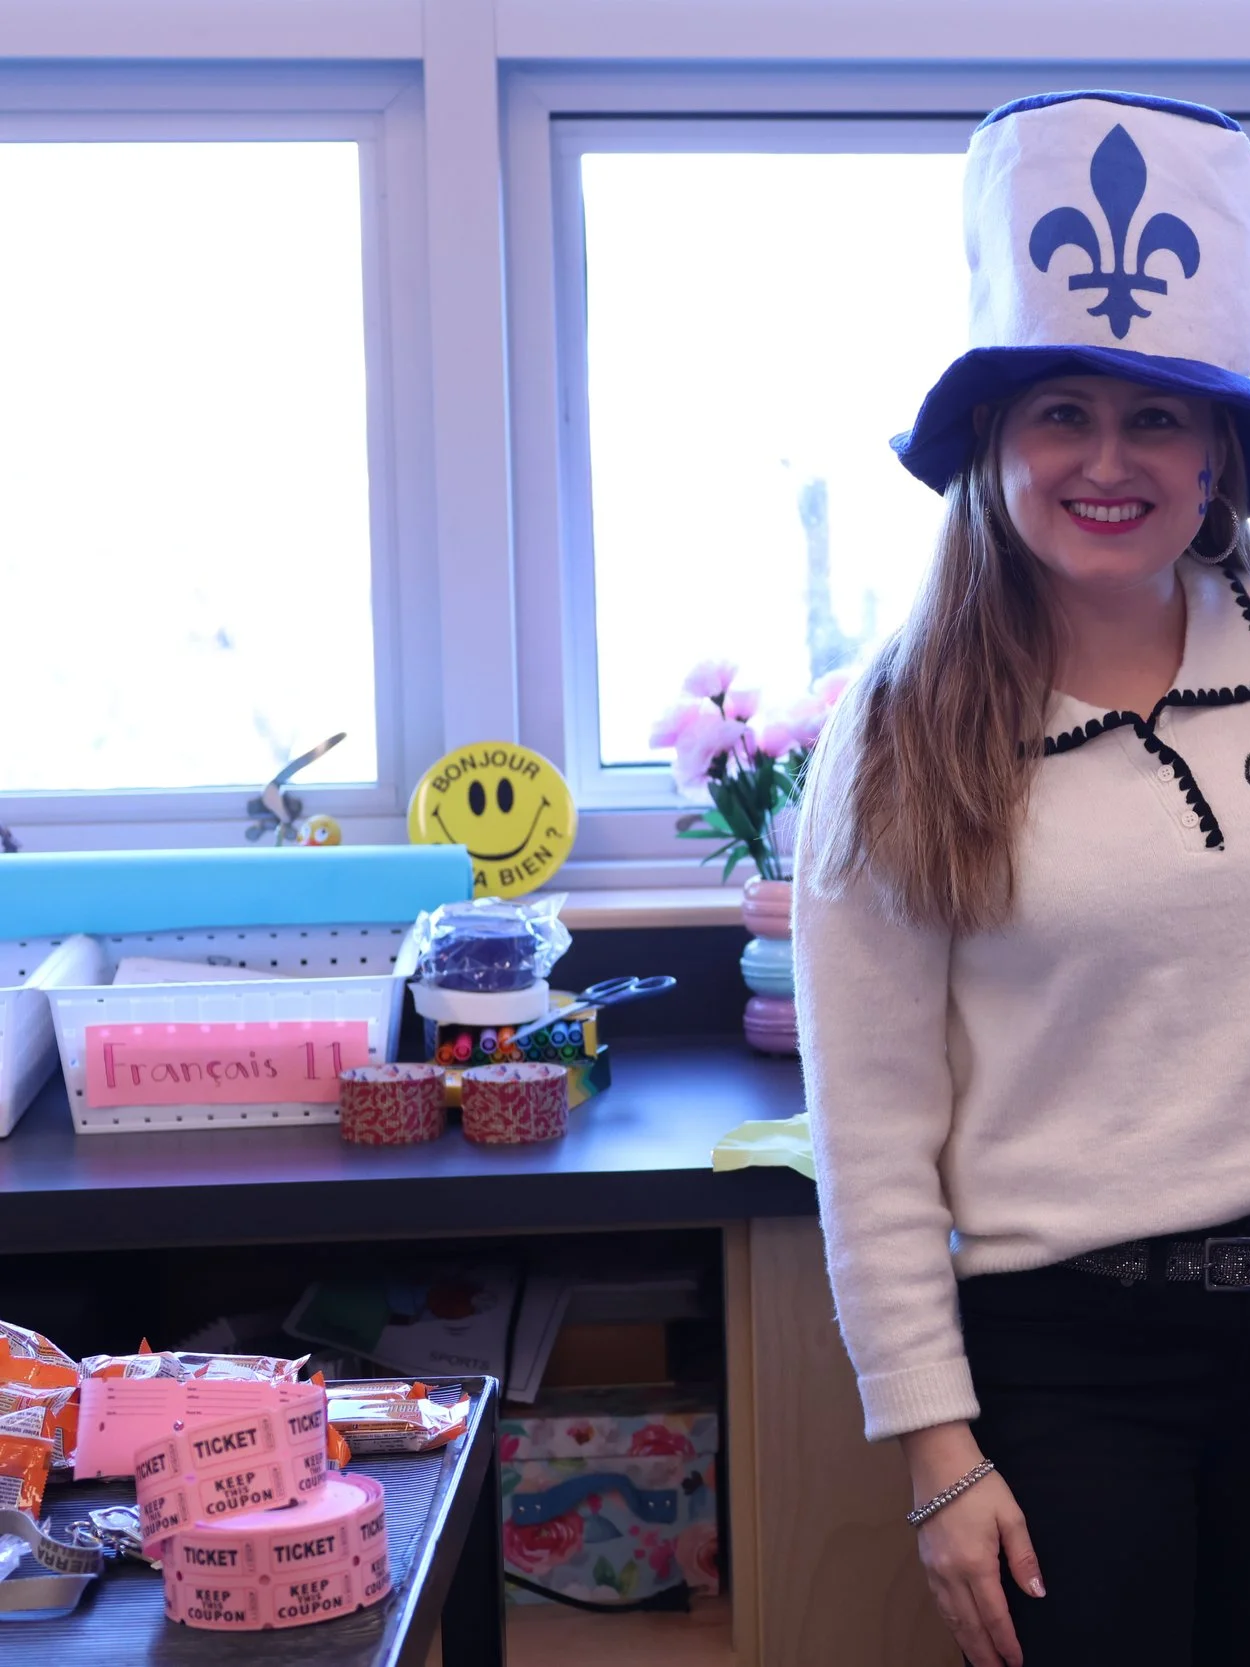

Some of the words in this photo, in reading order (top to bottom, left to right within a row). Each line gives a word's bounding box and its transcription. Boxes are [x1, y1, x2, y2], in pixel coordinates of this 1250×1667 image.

[431, 751, 541, 794] BONJOUR
[473, 870, 488, 888] A
[499, 845, 553, 887] BIEN
[545, 826, 563, 839] ?
[103, 1042, 278, 1089] Français
[298, 1041, 343, 1081] 11
[429, 1350, 490, 1371] SPORTS
[193, 1427, 258, 1460] TICKET
[215, 1472, 255, 1491] KEEP
[224, 1486, 249, 1498] THIS
[144, 1497, 165, 1514] KEEP
[206, 1489, 273, 1515] COUPON
[183, 1547, 239, 1568] TICKET
[273, 1536, 335, 1563] TICKET
[195, 1588, 231, 1603] KEEP
[290, 1579, 330, 1597] KEEP
[297, 1592, 322, 1604] THIS
[187, 1606, 246, 1623] COUPON
[202, 1599, 223, 1611] THIS
[277, 1596, 343, 1620] COUPON
